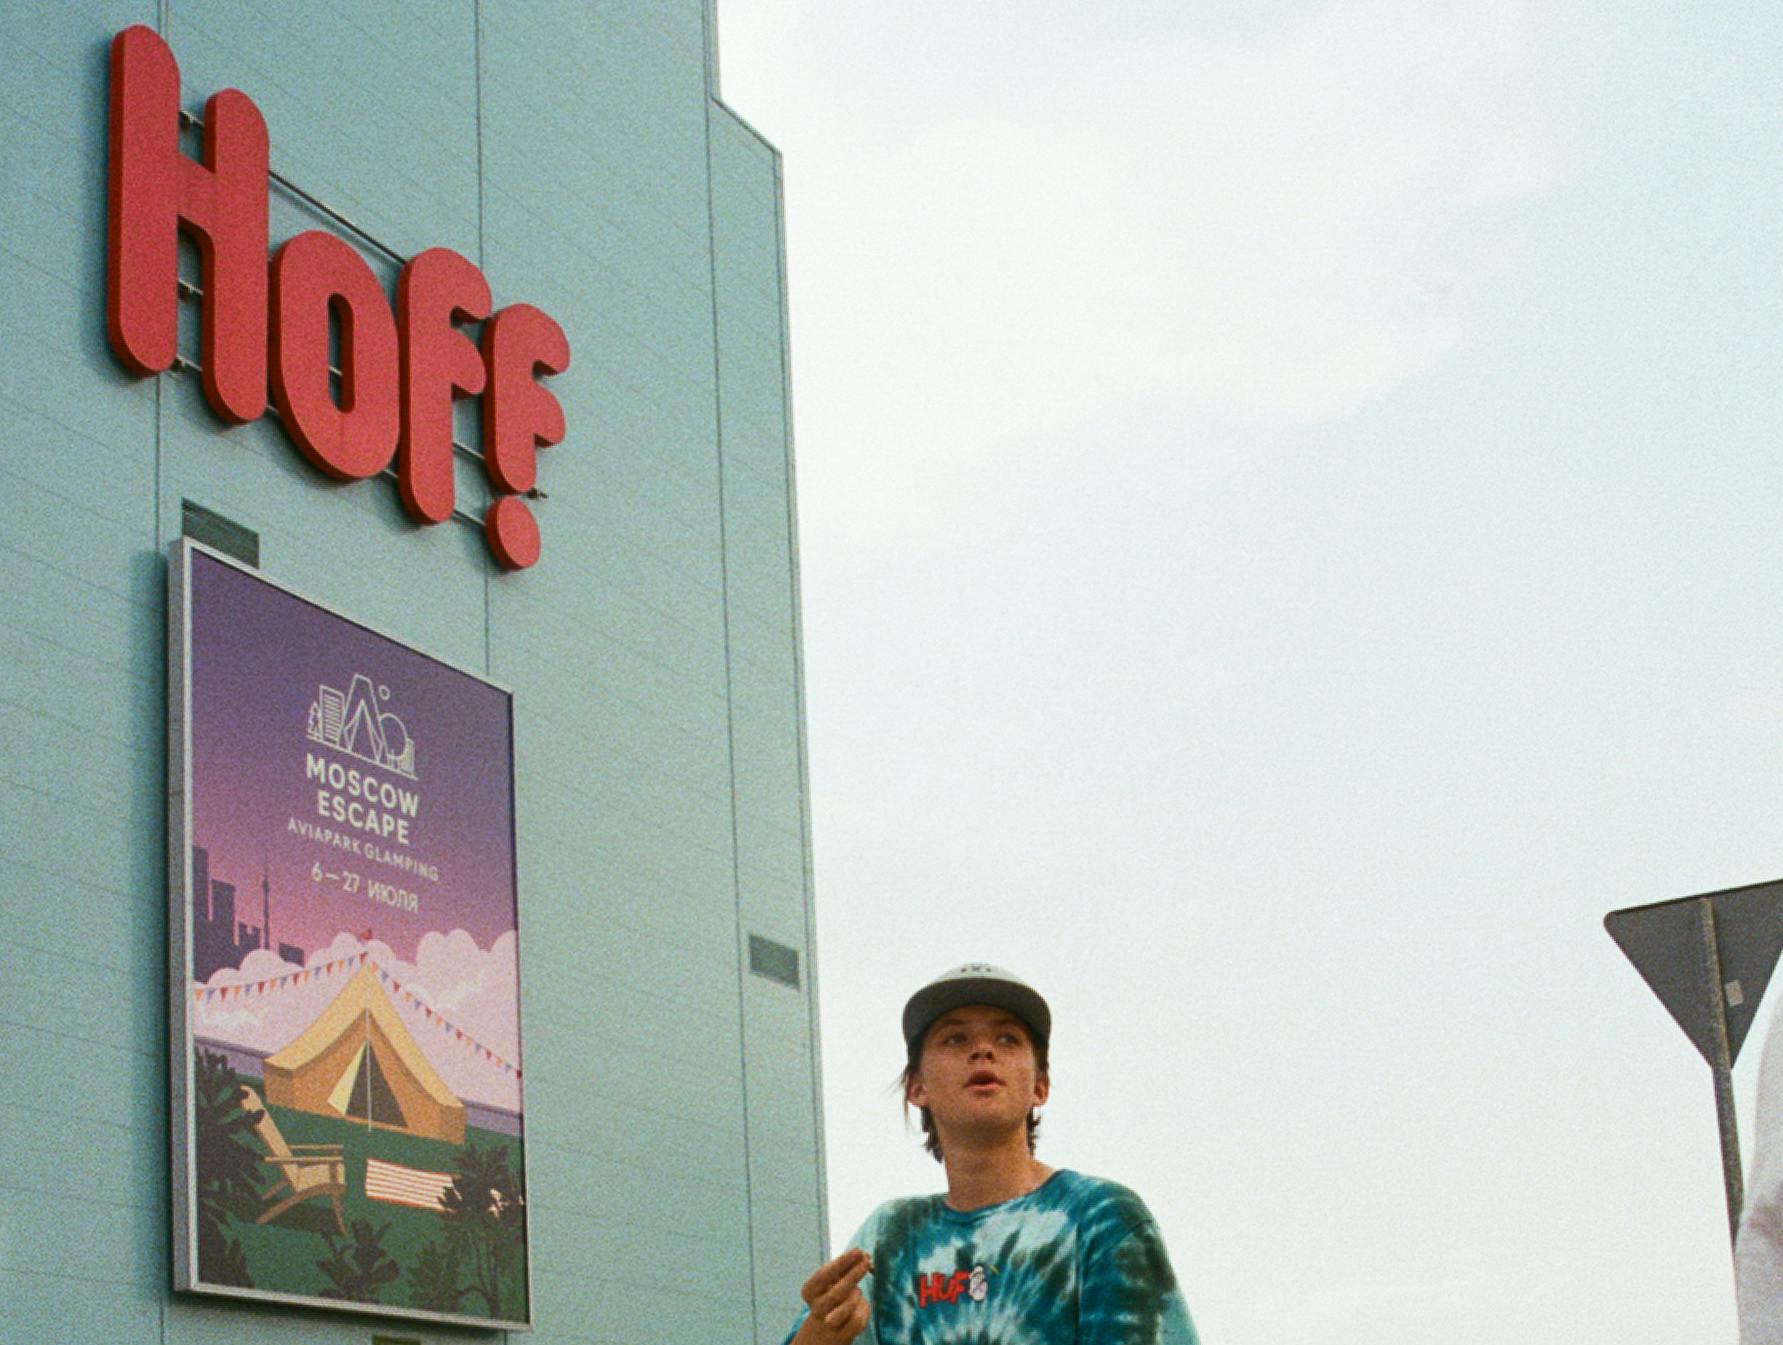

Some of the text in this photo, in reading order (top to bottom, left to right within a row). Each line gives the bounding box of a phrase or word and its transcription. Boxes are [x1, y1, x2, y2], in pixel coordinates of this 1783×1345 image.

[306, 752, 418, 818] MOSCOW
[318, 789, 409, 845] ESCAPE
[287, 817, 440, 882] AVIAPARK GLAMPING
[367, 879, 418, 913] ИЮЛЯ
[918, 1270, 969, 1308] HUF
